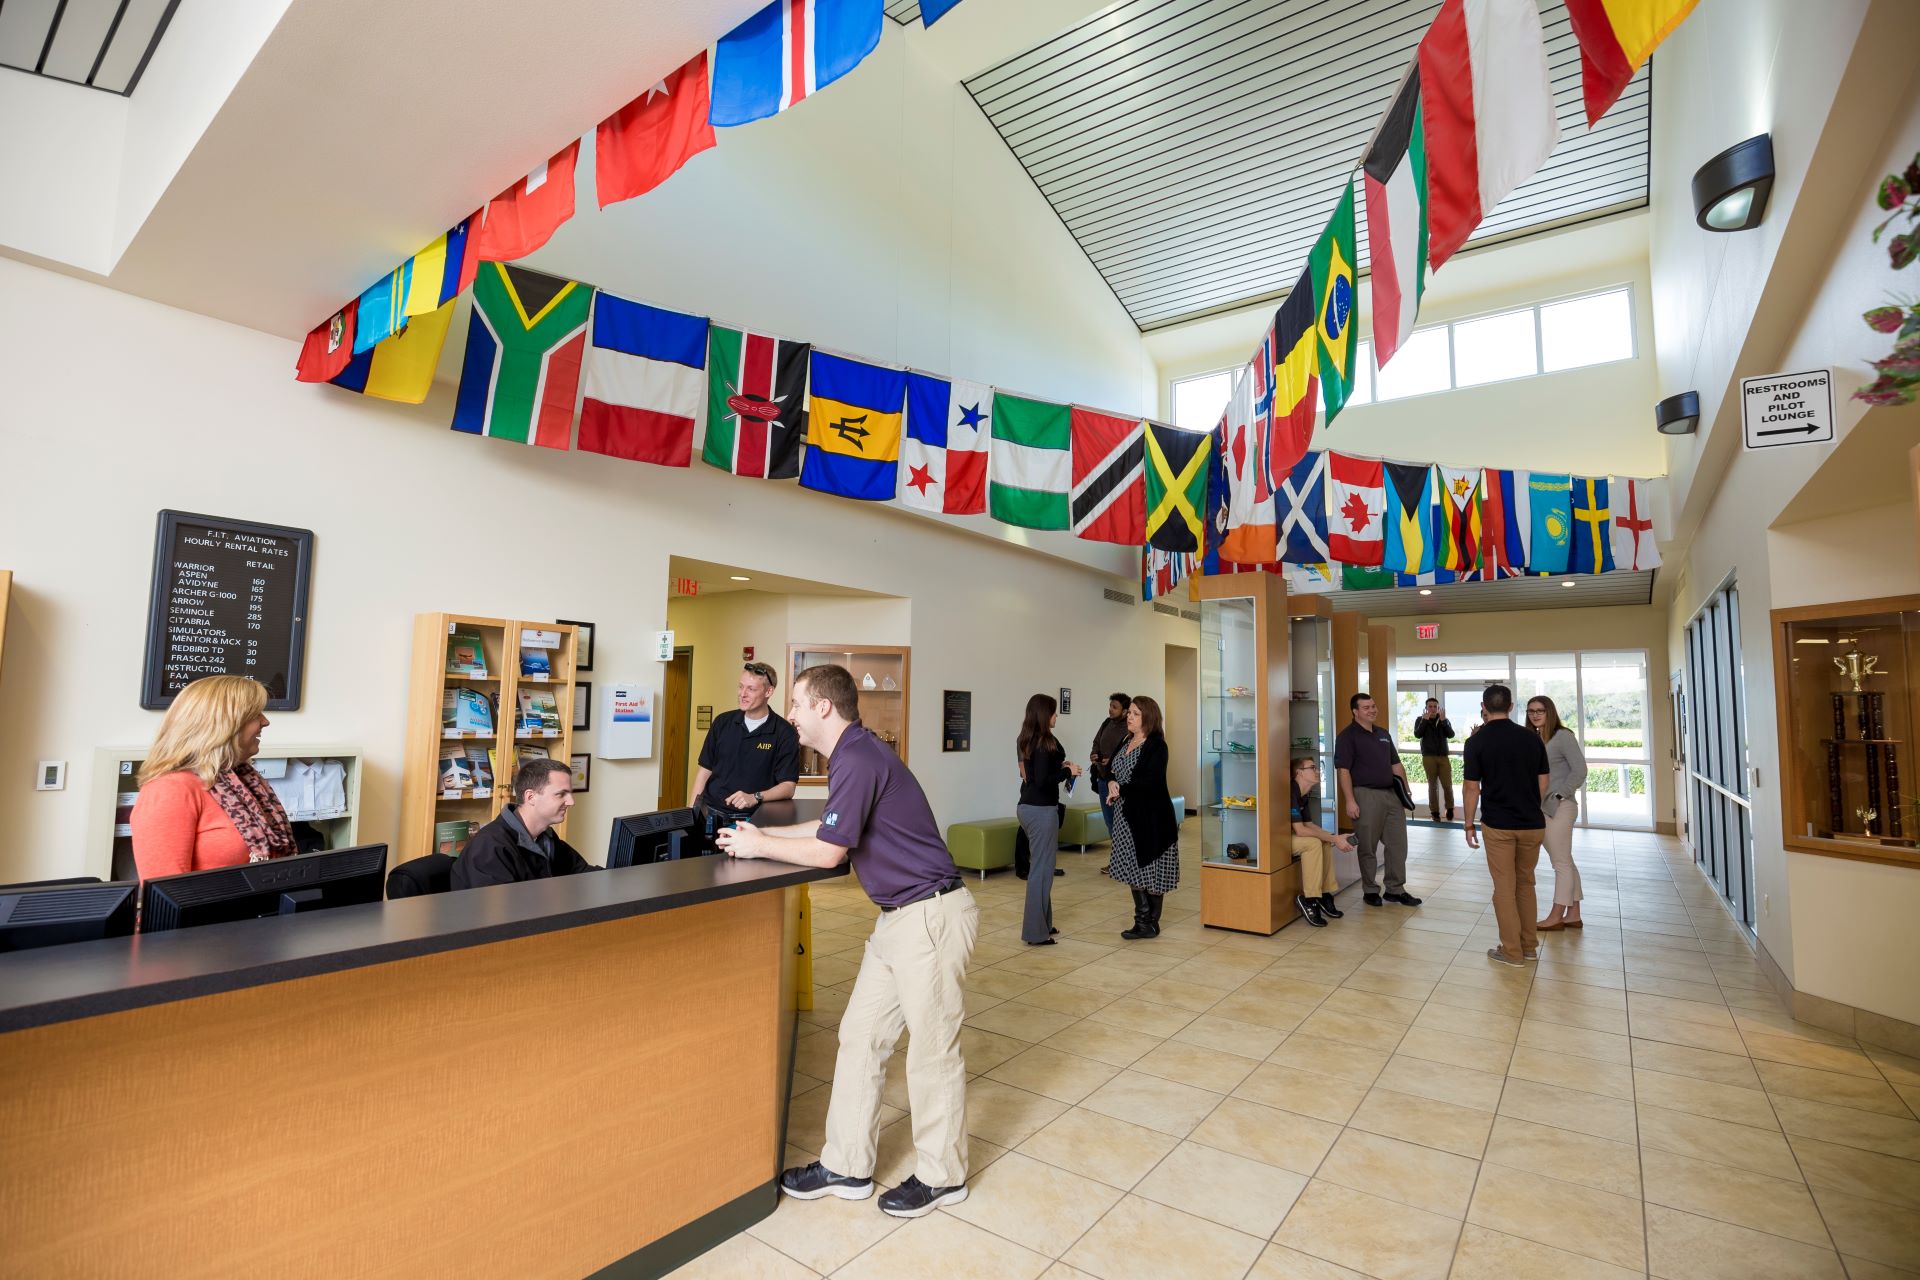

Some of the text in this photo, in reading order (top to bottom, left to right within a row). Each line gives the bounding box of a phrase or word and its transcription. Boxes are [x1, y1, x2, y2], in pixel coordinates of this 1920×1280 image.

[1746, 378, 1827, 395] RESTROOMS
[1773, 391, 1801, 402] AND
[1768, 401, 1805, 412] PILOT
[1761, 410, 1815, 423] LOUNGE
[207, 530, 277, 546] F.I.T. AVIATION
[184, 537, 289, 557] HOURLY RENTAL RATES
[174, 561, 215, 572] WARRIOR
[246, 560, 275, 570] RETAIL
[179, 570, 208, 579] ASPEN
[178, 578, 265, 588] AVIDYNE 160
[172, 587, 207, 597] ARCHER
[209, 591, 237, 600] G-1000
[171, 595, 263, 606] ARROW 175
[169, 604, 262, 617] SEMINOLE 195
[168, 613, 262, 626] CITABRIA 285
[168, 622, 260, 637] SIMULATORS 170
[1419, 626, 1435, 639] EXIT
[172, 635, 212, 644] MENTOR
[220, 638, 241, 646] MCX
[247, 639, 258, 647] 50
[171, 644, 209, 653] REDBIRD
[211, 646, 224, 654] TD
[171, 654, 207, 663] FRASCA
[209, 656, 225, 664] 242
[165, 664, 226, 674] INSTRUCTION
[169, 672, 189, 680] FAA
[122, 763, 130, 772] 2
